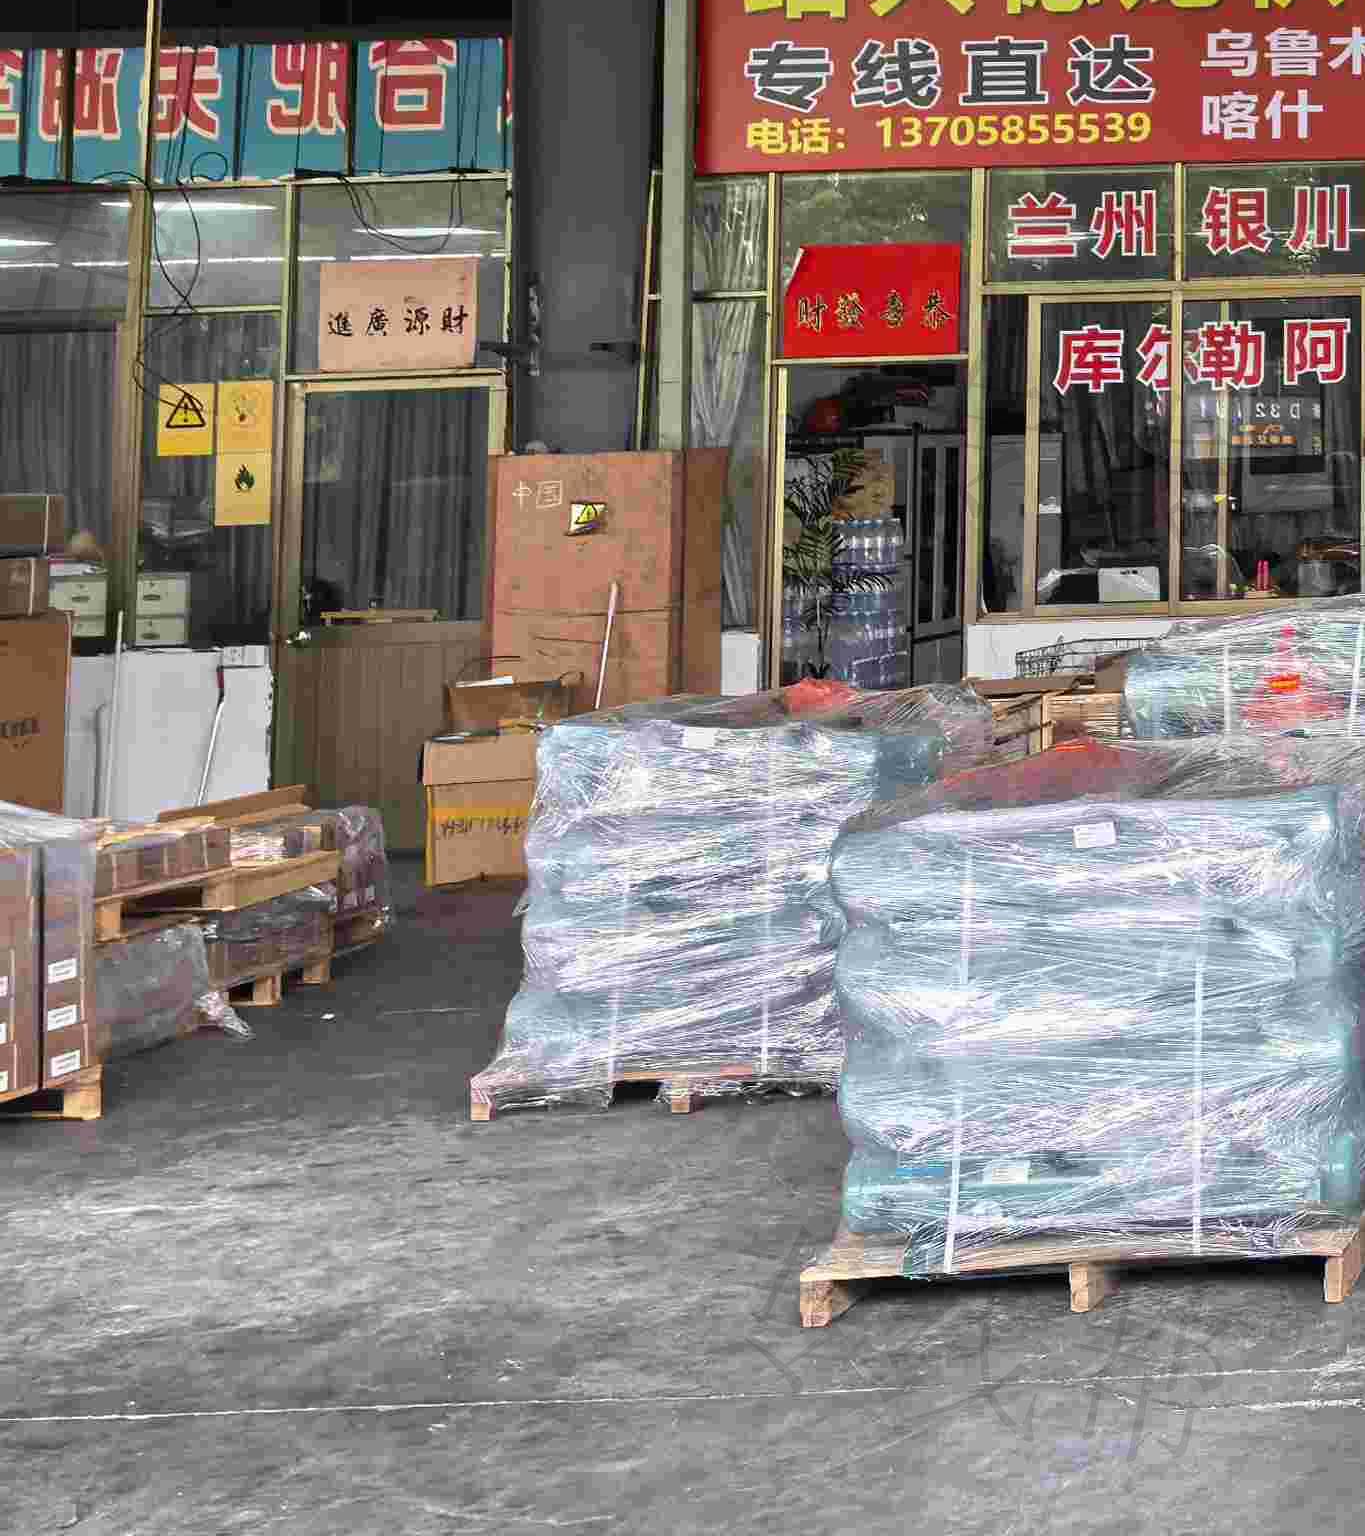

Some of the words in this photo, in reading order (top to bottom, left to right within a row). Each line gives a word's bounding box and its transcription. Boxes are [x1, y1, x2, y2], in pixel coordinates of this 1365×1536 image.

[745, 35, 1155, 112] 专线直达
[1202, 89, 1325, 141] 喀什
[1007, 189, 1157, 260] 兰州
[1202, 183, 1351, 256] 银川
